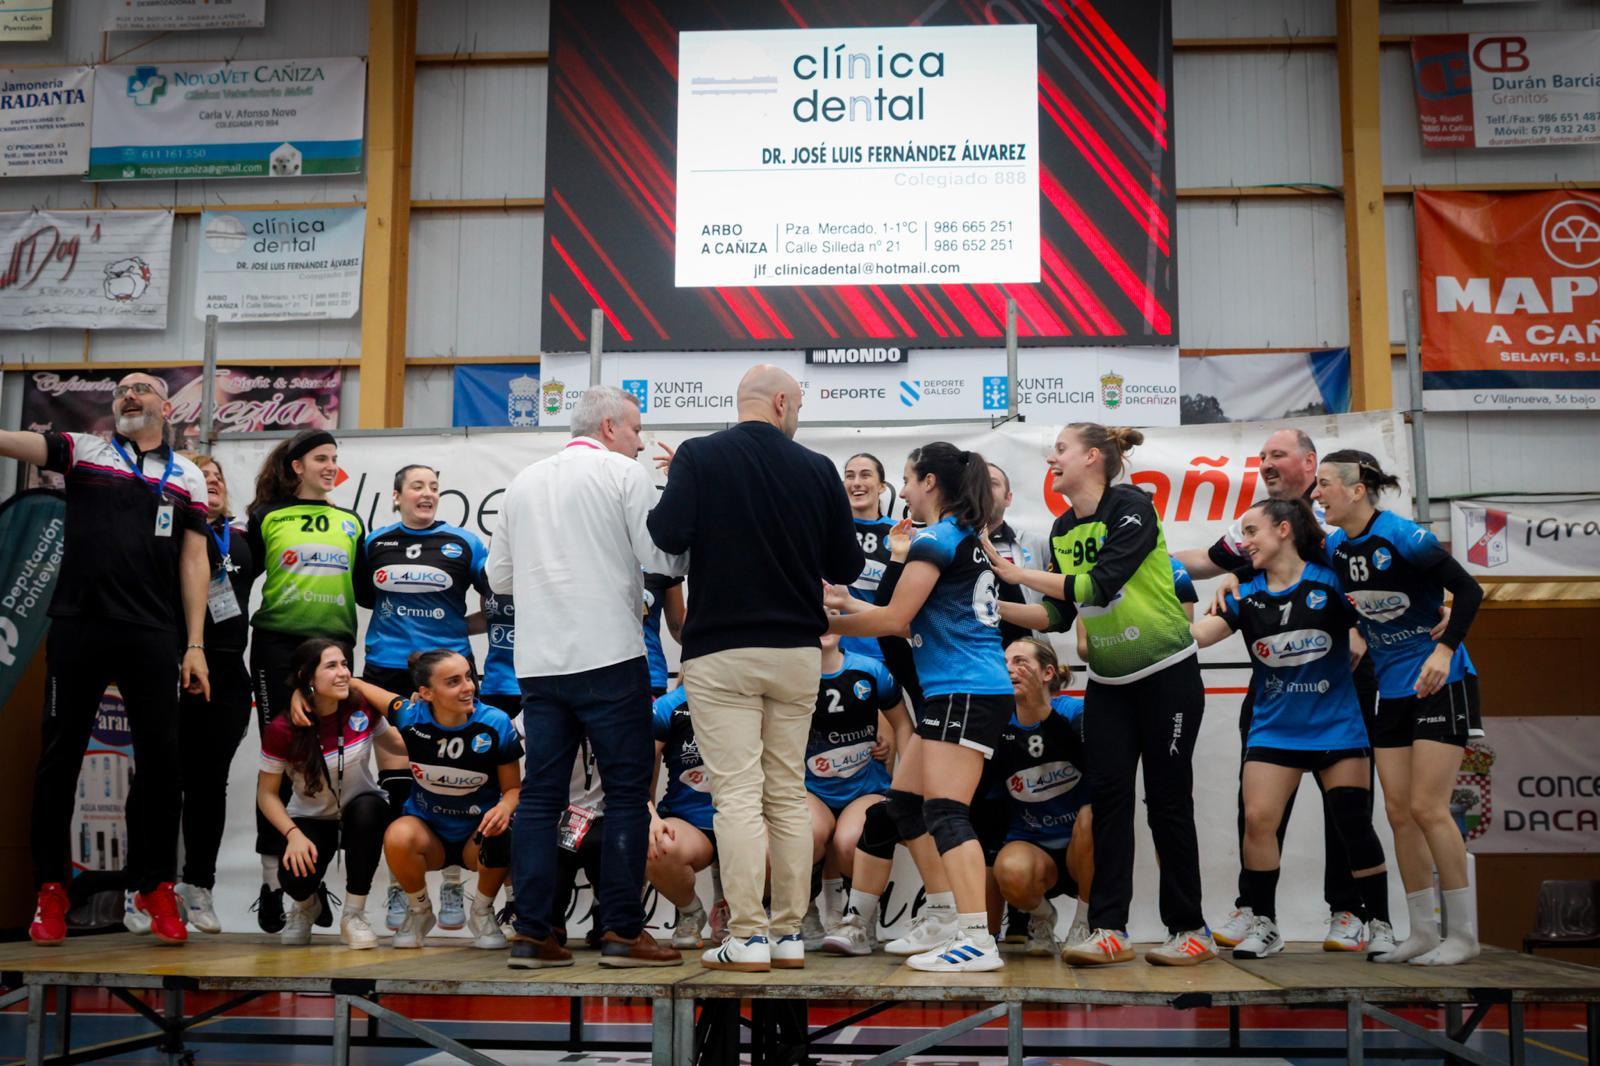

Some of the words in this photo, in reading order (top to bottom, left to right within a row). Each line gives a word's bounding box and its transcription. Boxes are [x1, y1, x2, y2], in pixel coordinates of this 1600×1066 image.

[793, 44, 944, 80] clínica
[1492, 75, 1546, 90] Durán
[793, 87, 924, 123] dental
[1492, 92, 1549, 105] Granitos
[1538, 112, 1557, 123] 986
[1531, 124, 1551, 135] 679
[762, 146, 786, 165] DR.
[791, 141, 827, 165] JOSÉ
[832, 145, 863, 164] LUIS
[868, 140, 956, 163] FERNÁNDEZ
[961, 138, 1026, 161] ÁLVAREZ
[894, 172, 988, 189] Colegiado
[994, 170, 1026, 186] 888
[252, 217, 325, 235] clínica
[701, 223, 743, 236] ARBO
[934, 220, 958, 233] 986
[962, 220, 986, 233] 665
[990, 220, 1014, 233] 251
[253, 236, 316, 254] dental
[701, 242, 711, 255] A
[714, 238, 768, 255] CAÑIZA
[785, 240, 818, 254] Calle
[822, 240, 865, 254] Silleda
[886, 239, 901, 252] 21
[934, 239, 958, 252] 986
[962, 239, 986, 252] 652
[990, 239, 1014, 252] 251
[270, 261, 285, 270] LUIS
[1486, 324, 1513, 345] A
[826, 348, 900, 363] MONDO
[1500, 351, 1569, 365] SELAYFI,
[653, 381, 703, 394] XUNTA
[924, 379, 966, 388] DEPORTE
[1017, 377, 1064, 391] XUNTA
[820, 388, 886, 400] DEPORTE
[923, 387, 961, 396] GALEGO
[1036, 391, 1095, 405] GALICIA
[653, 395, 672, 409] DE
[673, 394, 734, 409] GALICIA
[1569, 393, 1597, 406] bajo
[300, 514, 330, 533] 20
[405, 543, 422, 559] 6
[1072, 536, 1099, 567] 98
[2, 517, 63, 610] Deputación
[1349, 555, 1369, 582] 63
[389, 571, 447, 584] L4UKO
[396, 604, 446, 620] ermua
[826, 688, 844, 714] 2
[436, 737, 464, 760] 10
[1028, 734, 1044, 758] 8
